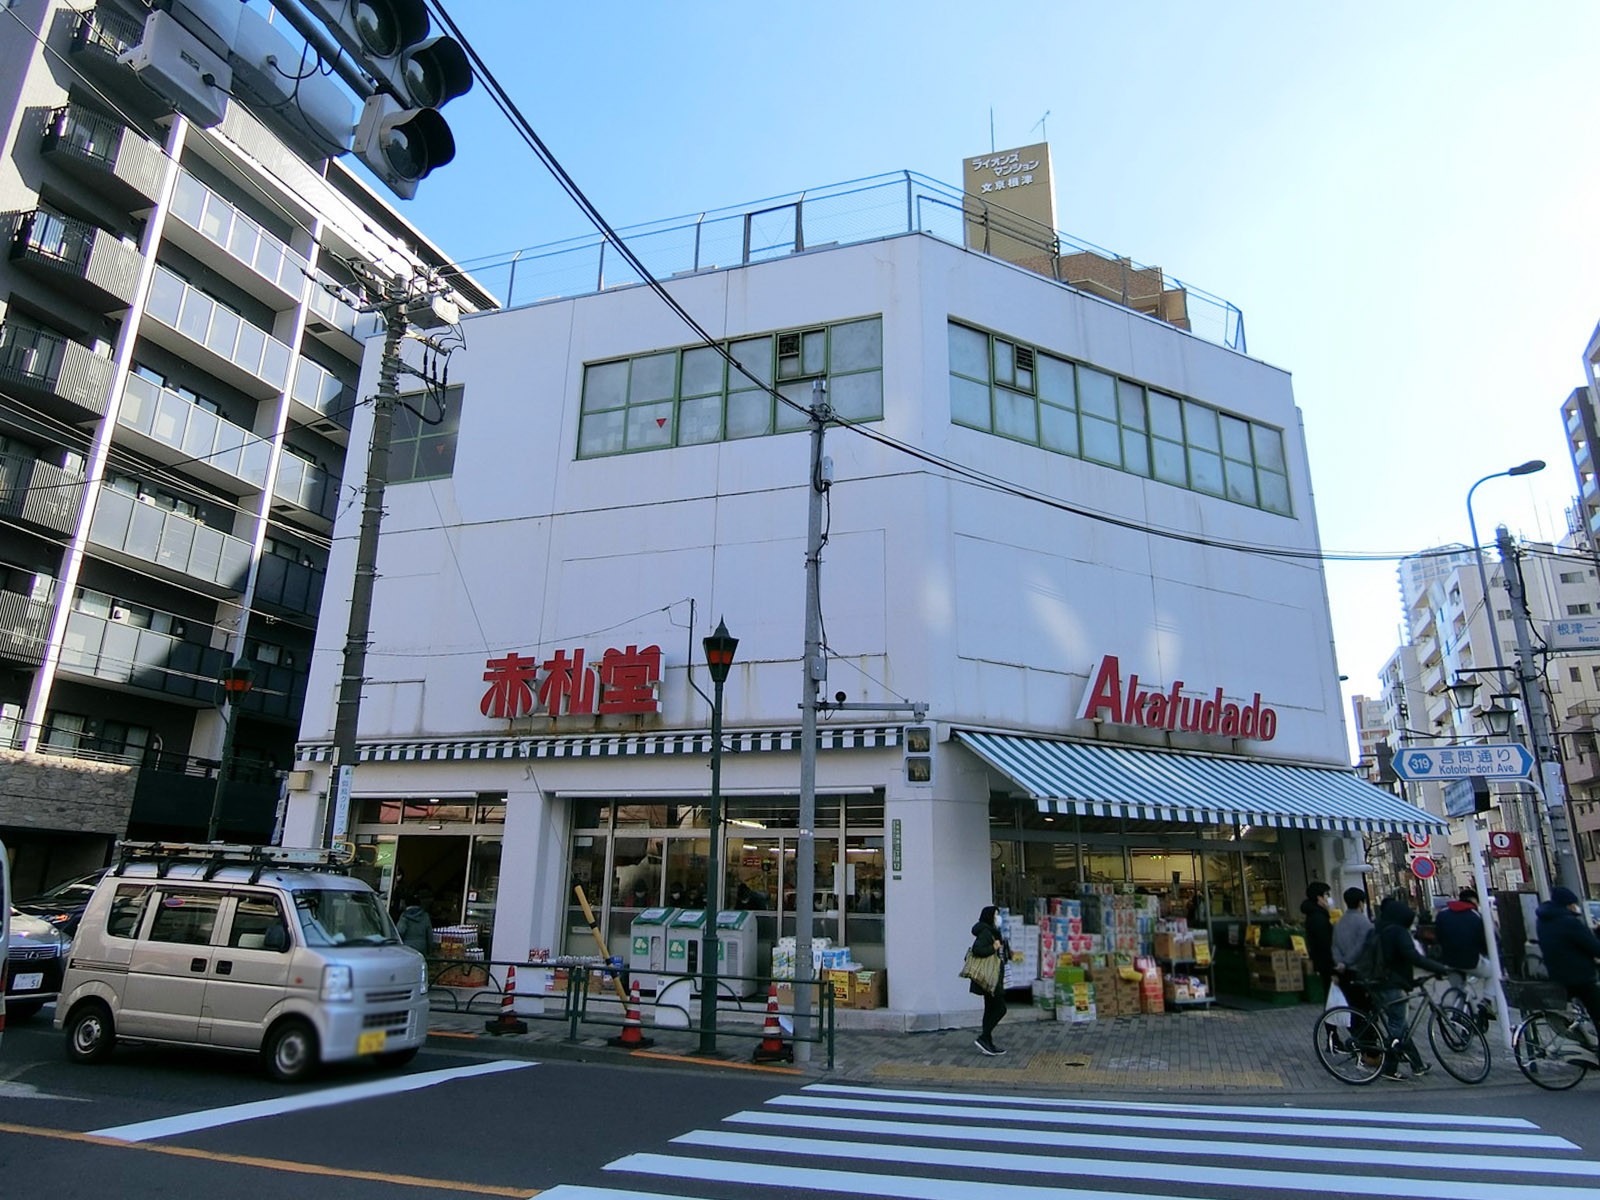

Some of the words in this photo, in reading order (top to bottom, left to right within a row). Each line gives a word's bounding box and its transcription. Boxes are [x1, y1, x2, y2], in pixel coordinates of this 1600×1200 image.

[972, 152, 1019, 171] ライオンズ
[993, 160, 1040, 177] マンション
[480, 645, 664, 719] 赤札堂
[1082, 654, 1277, 741] Akafudado
[1411, 759, 1430, 770] 319
[1439, 749, 1510, 763] 言問通り
[1439, 764, 1494, 775] Kototoi-dori
[1497, 763, 1517, 773] Ave.
